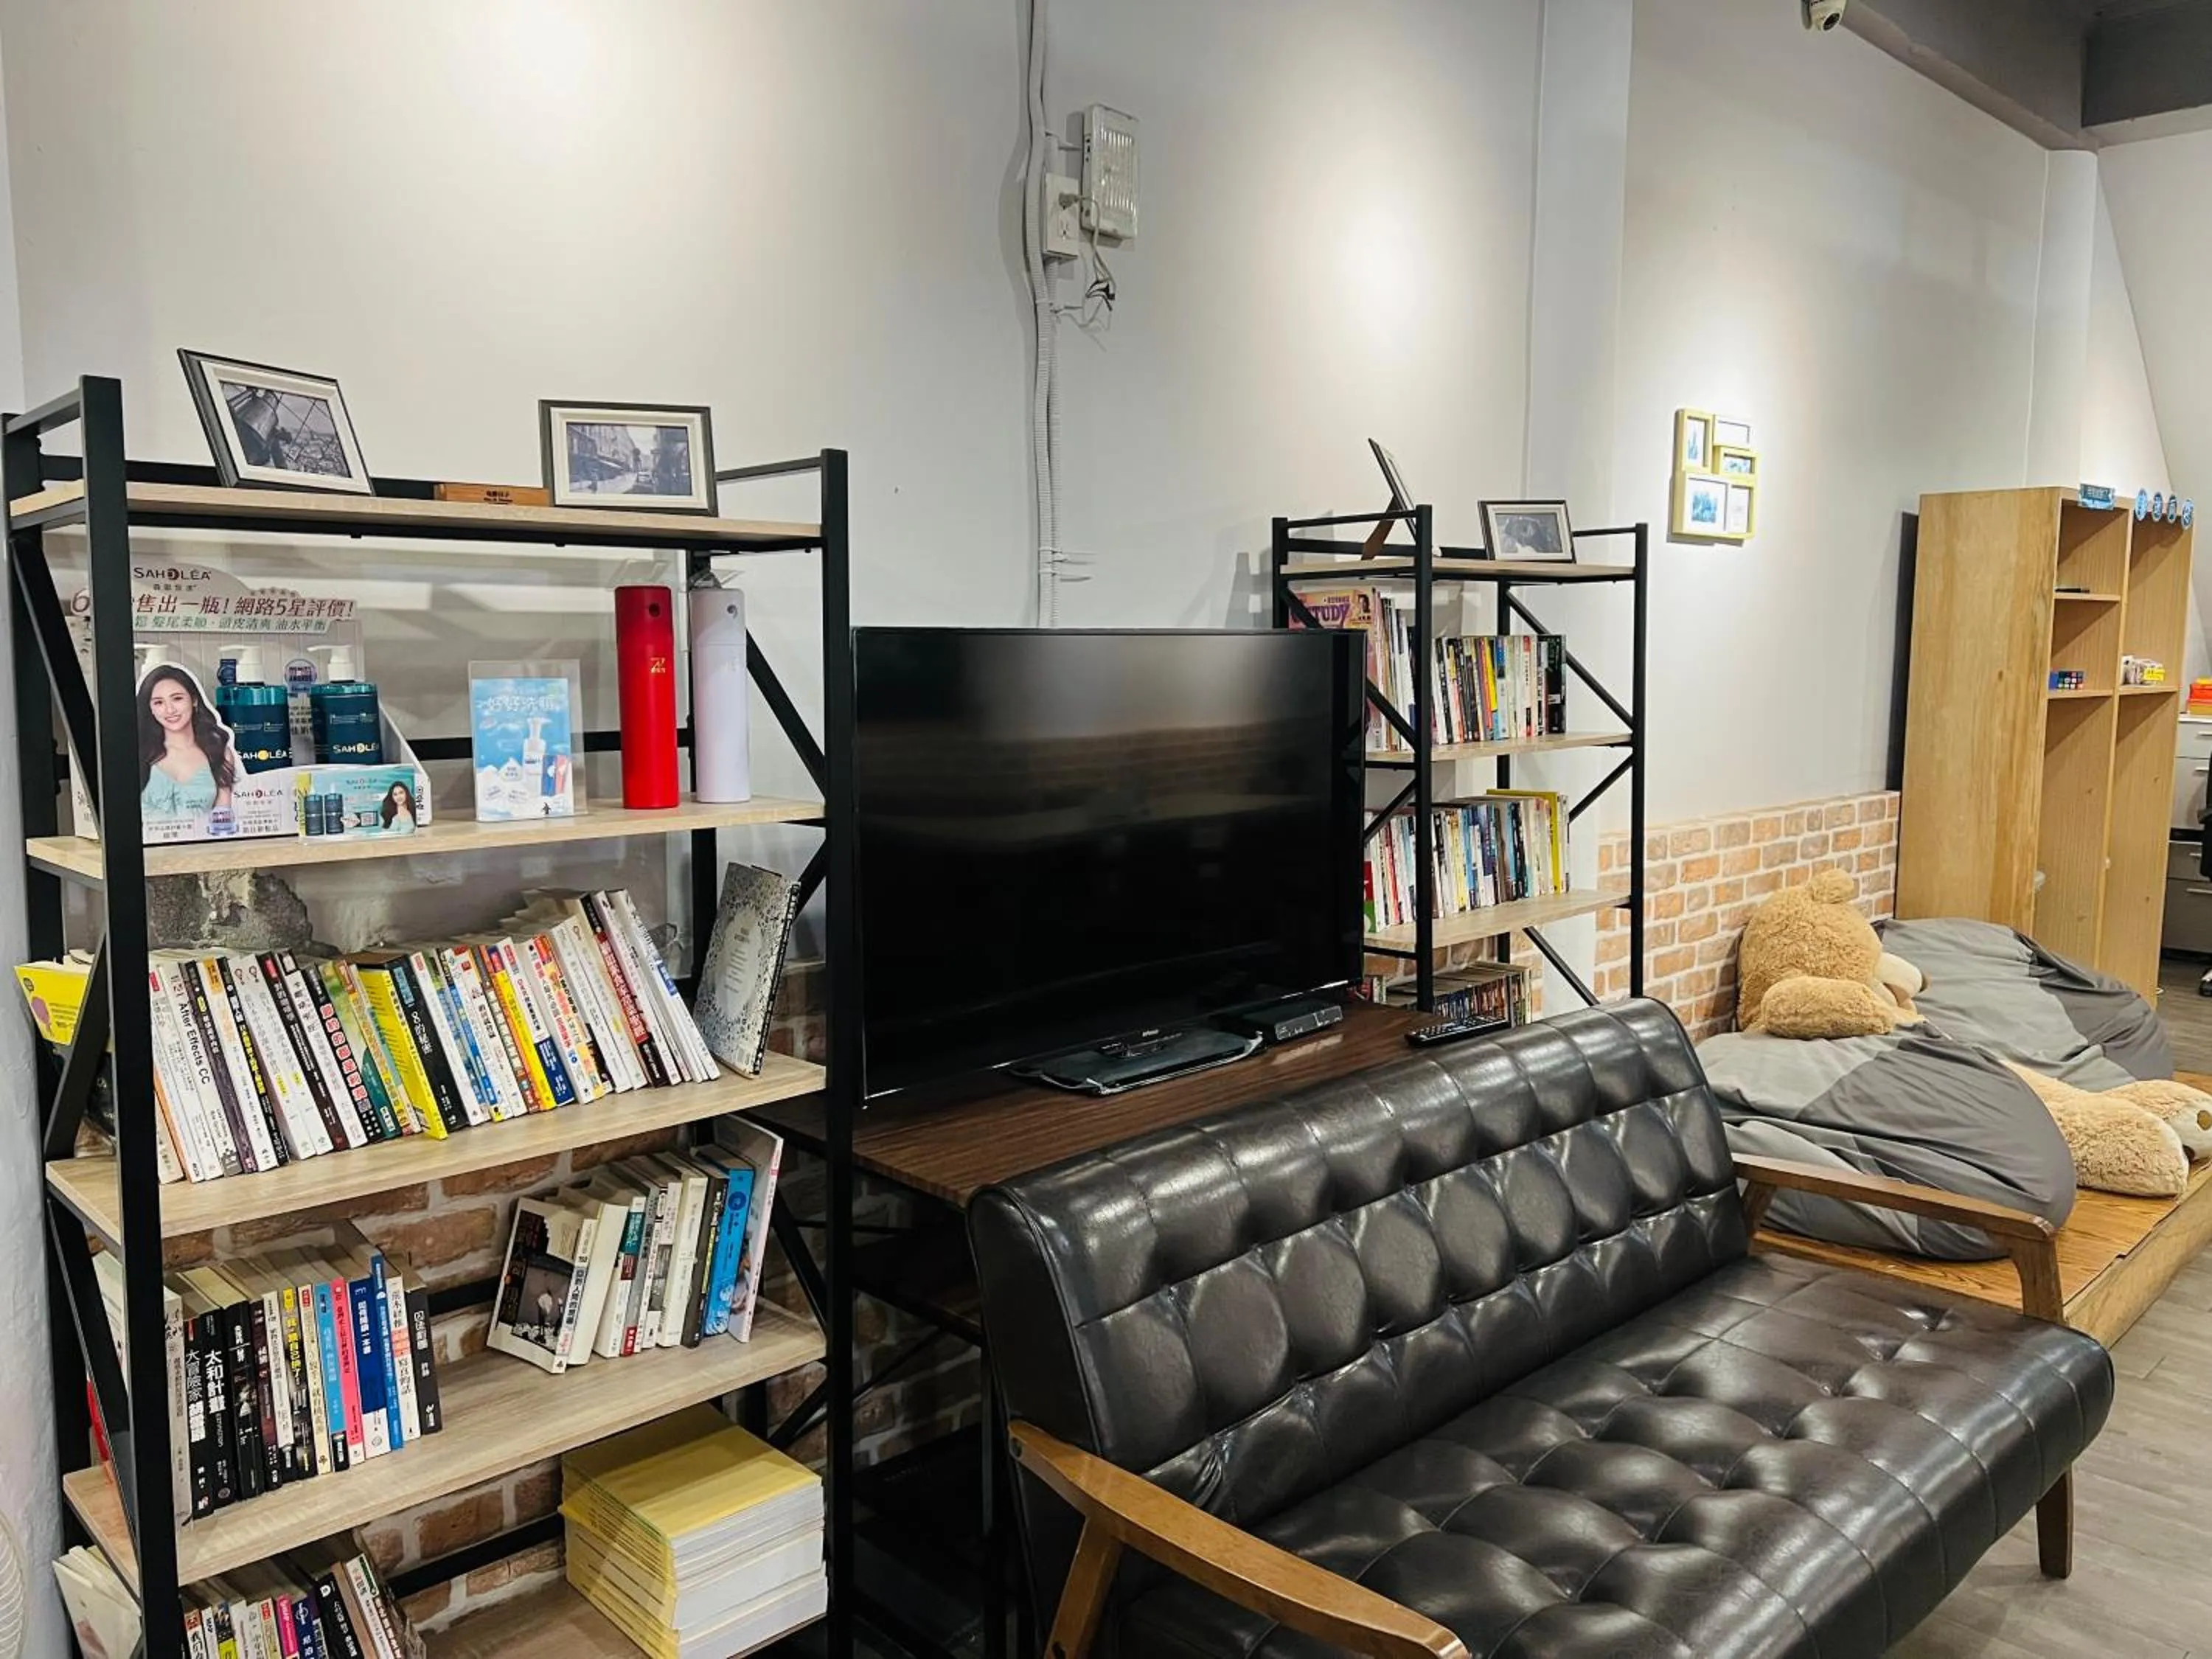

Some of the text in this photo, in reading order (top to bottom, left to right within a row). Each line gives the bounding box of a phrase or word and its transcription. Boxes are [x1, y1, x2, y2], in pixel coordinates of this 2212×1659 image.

[179, 1001, 192, 1027] After
[187, 1029, 204, 1067] Effects
[198, 1068, 210, 1085] CC
